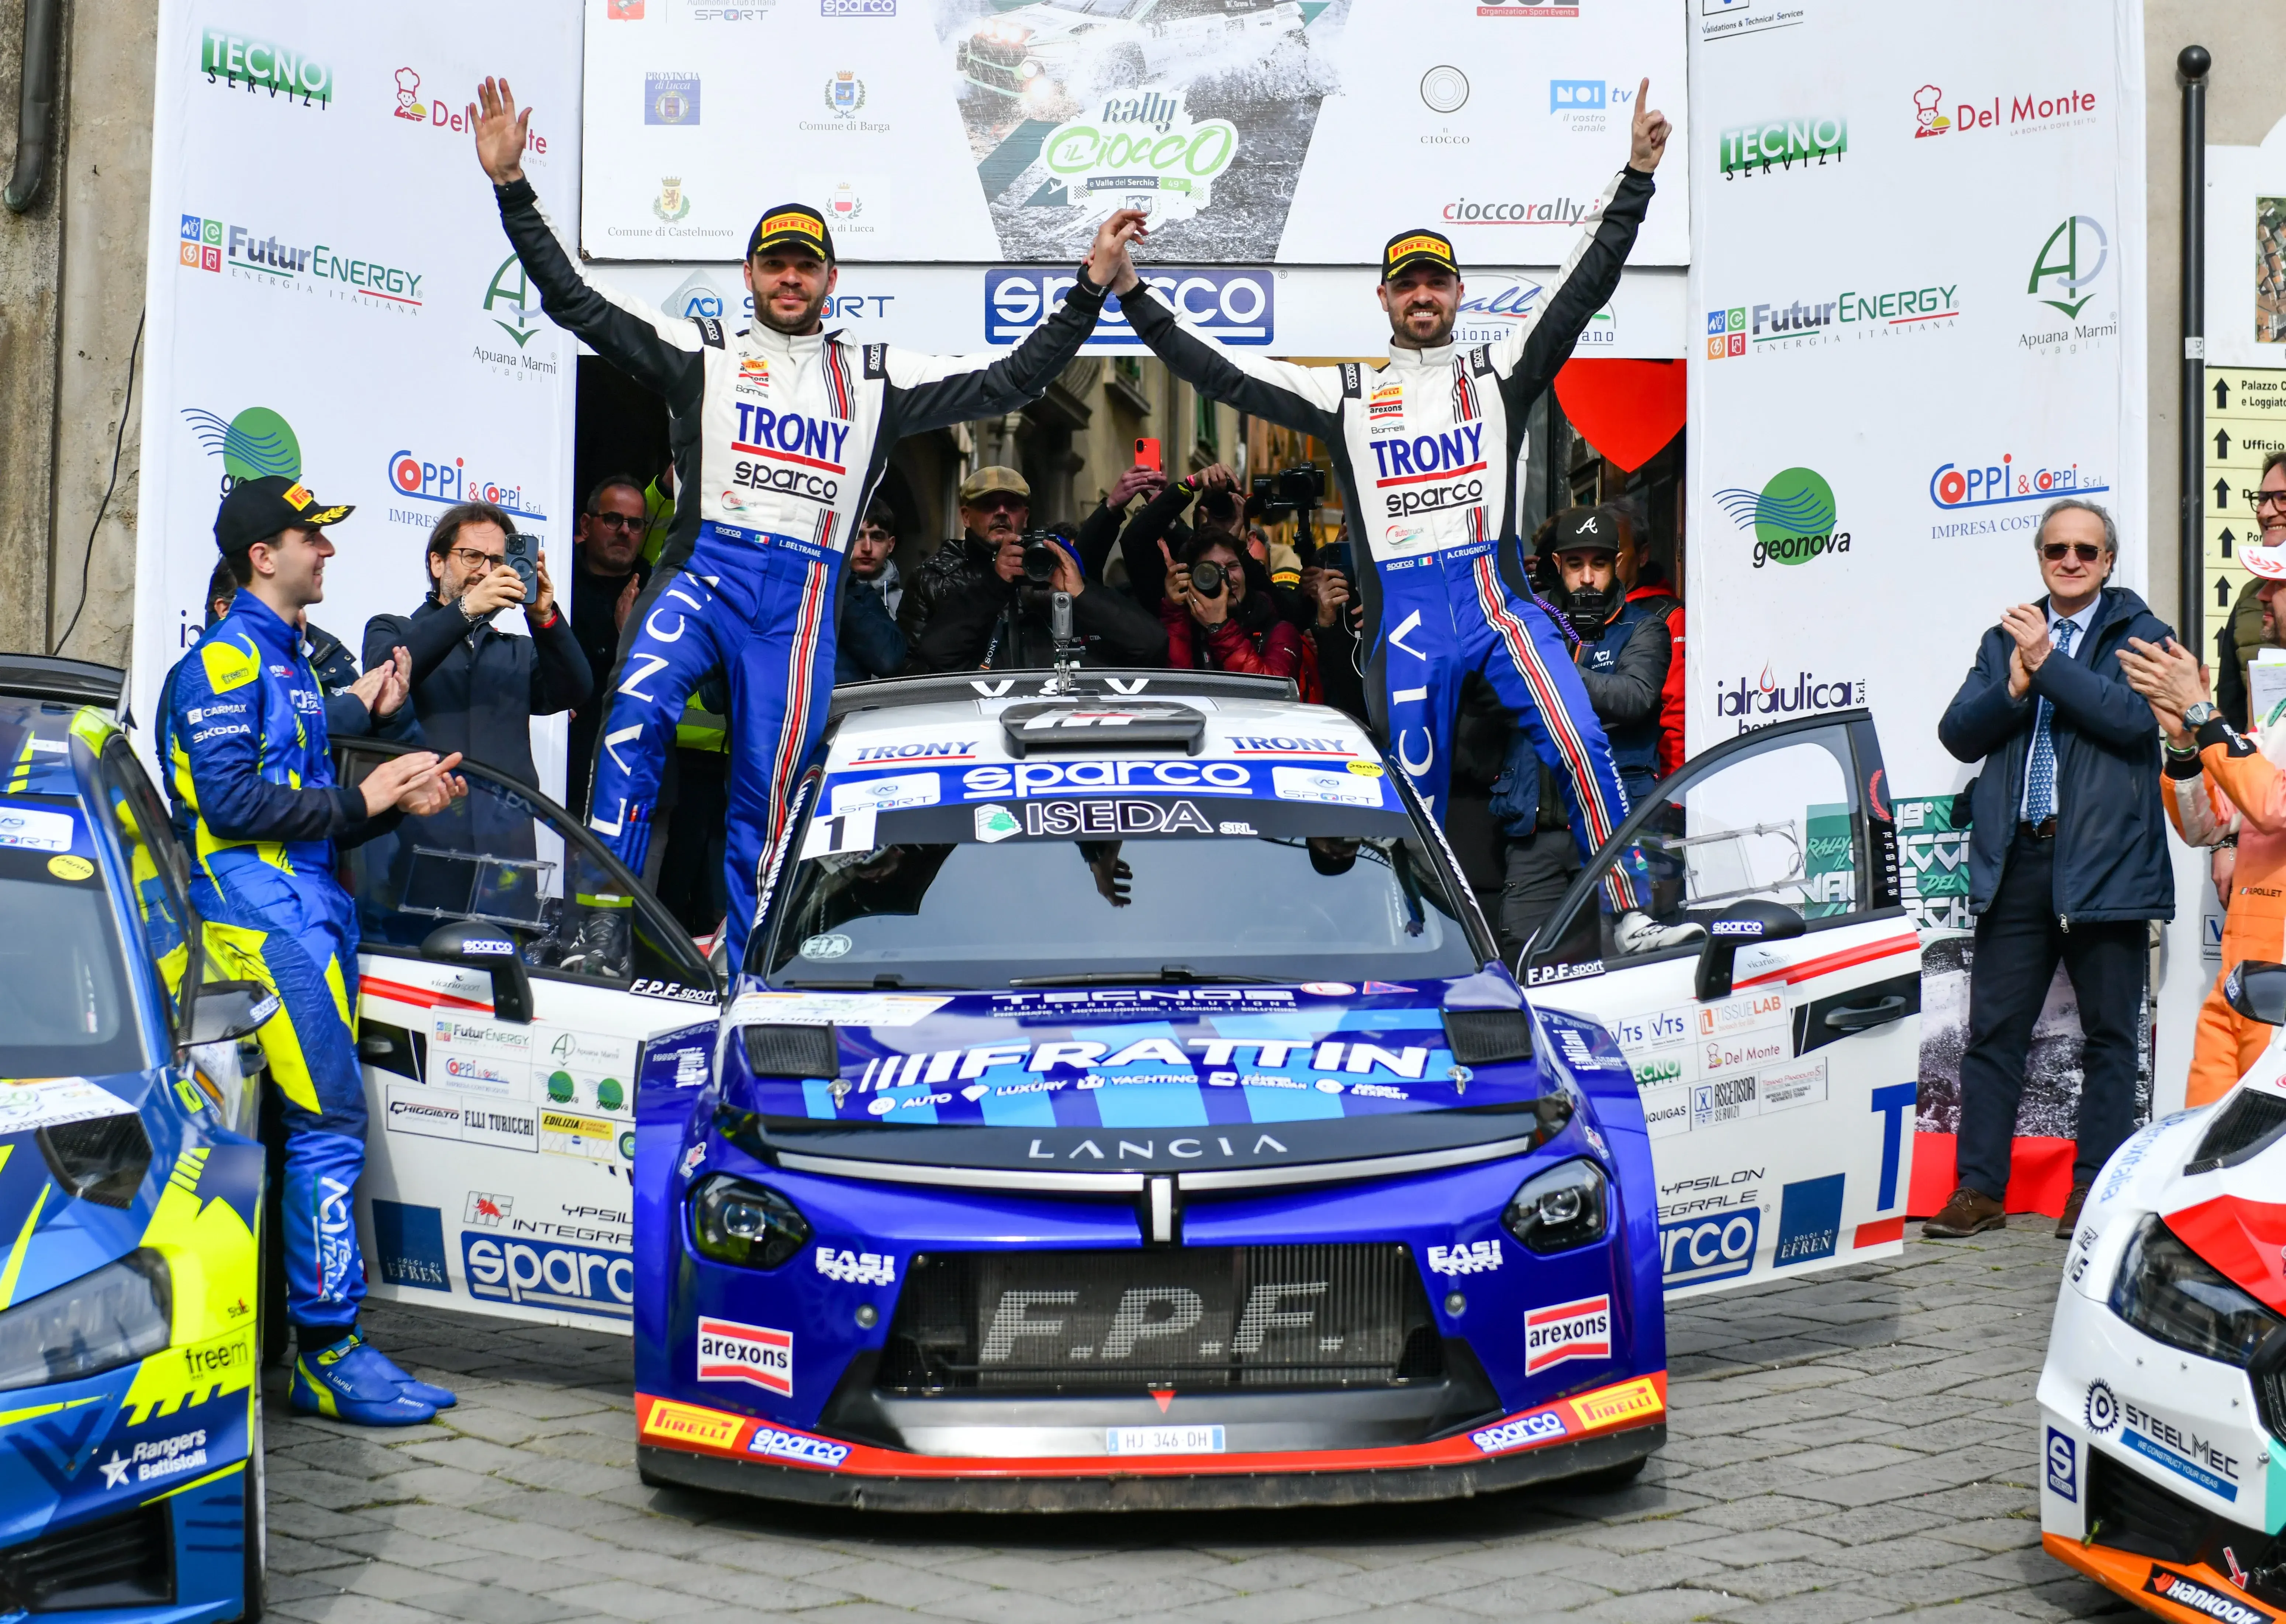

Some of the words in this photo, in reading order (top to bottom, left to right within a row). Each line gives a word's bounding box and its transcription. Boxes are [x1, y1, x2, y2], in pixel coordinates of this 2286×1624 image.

[823, 0, 894, 16] sparco
[1702, 22, 1736, 34] Validations
[1745, 15, 1773, 27] Technical
[1776, 9, 1803, 20] Services
[209, 33, 327, 91] TECNO
[645, 72, 700, 81] PROVINCIA
[655, 81, 663, 89] di
[666, 81, 690, 89] Lucca
[208, 66, 326, 111] SERVIZI
[1557, 86, 1598, 103] NOI
[1612, 88, 1632, 103] tv
[433, 100, 468, 133] Del
[1563, 114, 1570, 122] il
[1958, 97, 2000, 132] Del
[2011, 90, 2096, 124] Monte
[799, 122, 843, 131] Comune
[847, 121, 857, 131] di
[860, 121, 890, 133] Barga
[1571, 123, 1606, 132] canale
[2050, 121, 2071, 129] DOVE
[1421, 136, 1470, 144] CIOCCO
[1726, 118, 1842, 164] TECNO
[1726, 146, 1843, 182] SERVIZI
[1095, 179, 1113, 187] Valle
[1115, 178, 1126, 187] del
[1127, 178, 1155, 187] Serchio
[1443, 198, 1600, 226] cioccorally.i
[608, 227, 653, 237] Comune
[656, 227, 666, 237] di
[669, 227, 733, 237] Castelnuovo
[766, 216, 821, 236] PIRELLI
[838, 224, 846, 232] di
[849, 224, 874, 232] Lucca
[1393, 238, 1446, 258] PIRELLI
[233, 269, 312, 295] ENERGIA
[330, 290, 417, 317] ITALIANA
[684, 297, 723, 317] ACI
[1757, 334, 1841, 353] ENERGIA
[1858, 319, 1954, 340] ITALIANA
[2019, 327, 2069, 350] Apuana
[2075, 321, 2117, 339] Marmi
[2040, 339, 2100, 357] vagli
[473, 346, 516, 366] Apuana
[522, 356, 556, 374] Marmi
[492, 367, 542, 383] vagli
[2241, 380, 2278, 391] Palazzo
[736, 402, 850, 463] TRONY
[1371, 425, 1405, 434] Barrelli
[1370, 422, 1482, 477] TRONY
[2243, 440, 2284, 450] Ufficio
[735, 462, 838, 500] sparco
[2018, 475, 2029, 494] &
[2083, 476, 2104, 488] S.r.l.
[469, 483, 479, 500] &
[1387, 480, 1482, 516] sparco
[716, 527, 741, 537] sparco
[1395, 526, 1424, 537] autotruck
[1931, 521, 1996, 540] IMPRESA
[780, 539, 821, 557] L.BELTRAME
[1447, 544, 1491, 559] A.CRUGNOLA
[1753, 530, 1850, 569] geonova
[1387, 559, 1414, 570] sparco
[985, 637, 997, 664] SONY
[1593, 650, 1610, 661] ACI
[970, 680, 1015, 697] V
[1104, 678, 1149, 694] V
[1717, 670, 1851, 717] idraulica
[203, 704, 246, 716] CARMAX
[856, 741, 980, 760] TRONY
[1224, 736, 1345, 752] TRONY
[963, 762, 1250, 797] sparco
[840, 796, 932, 813] SPORT
[1283, 790, 1375, 804] SPORT
[1026, 801, 1214, 835] ISEDA
[1220, 822, 1257, 834] SRL
[825, 816, 845, 851] 1
[1806, 835, 1851, 859] RALLY
[1835, 858, 1847, 869] IL
[1923, 874, 1957, 894] DEL
[1713, 921, 1762, 933] sparco
[463, 940, 513, 953] sparco
[804, 940, 845, 954] FIA
[1528, 960, 1604, 985] F.P.F.sport
[630, 979, 717, 1003] F.P.F.sport
[1715, 996, 1781, 1021] TISSUELAB
[1653, 1013, 1684, 1036] VTS
[958, 1038, 1427, 1079] FRATTIN
[1725, 1051, 1742, 1064] Del
[1746, 1045, 1779, 1060] Monte
[996, 1080, 1067, 1096] LUXURY
[1111, 1075, 1198, 1085] YACHTING
[1715, 1076, 1755, 1107] ASCENSORI
[546, 1092, 579, 1103] geonova
[596, 1100, 628, 1111] geonova
[901, 1093, 952, 1108] AUTO
[544, 1115, 579, 1128] EDILIZIA
[1646, 1106, 1685, 1123] IQUIGAS
[1715, 1106, 1739, 1121] SERVIZI
[489, 1113, 533, 1136] TURICCHI
[1029, 1134, 1287, 1159] LANCIA
[1661, 1167, 1765, 1195] YPSILON
[321, 1176, 349, 1233] ACI
[562, 1204, 632, 1224] YPSIL
[1795, 1233, 1817, 1241] DOLCI
[1781, 1236, 1831, 1259] EFREN
[317, 1234, 337, 1303] ITALIA
[388, 1262, 443, 1284] EFREN
[981, 1281, 1344, 1360] F.P.F.
[1530, 1316, 1606, 1348] arexons
[186, 1341, 249, 1375] freem
[702, 1336, 787, 1368] arexons
[1581, 1386, 1652, 1420] PIRELLI
[655, 1408, 732, 1440] PIRELLI
[1473, 1412, 1560, 1450] sparco
[132, 1430, 206, 1463] Rangers
[754, 1429, 847, 1463] sparco
[1153, 1432, 1178, 1447] 346
[1187, 1431, 1207, 1447] DH
[2126, 1403, 2238, 1480] STEELMEC
[138, 1449, 207, 1481] Battistolli
[2138, 1440, 2146, 1450] WE
[2147, 1445, 2181, 1468] CONSTRUCT
[2180, 1461, 2199, 1478] YOUR
[2200, 1471, 2218, 1489] IDEAS
[2050, 1475, 2071, 1495] sparco
